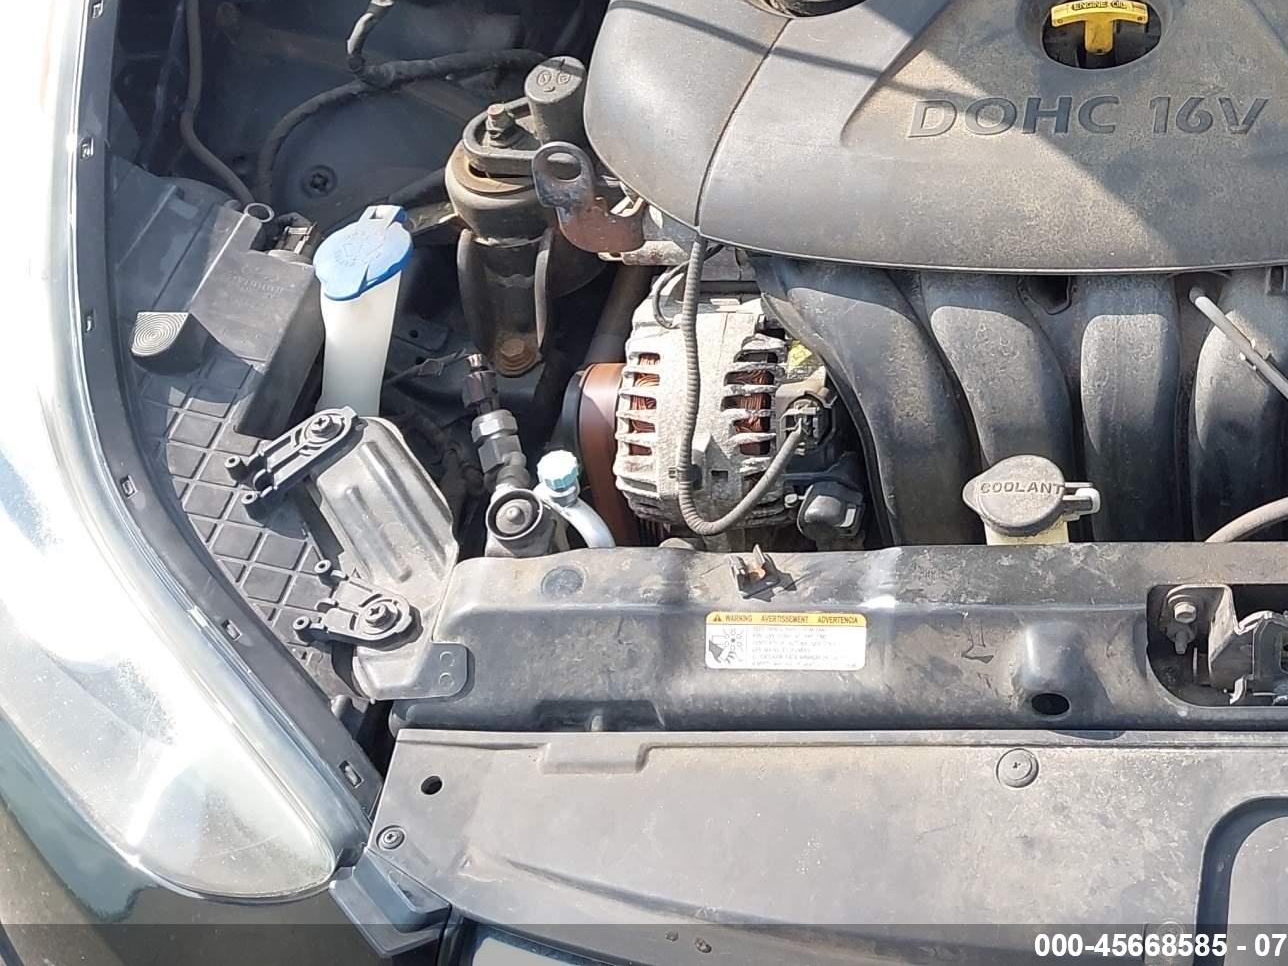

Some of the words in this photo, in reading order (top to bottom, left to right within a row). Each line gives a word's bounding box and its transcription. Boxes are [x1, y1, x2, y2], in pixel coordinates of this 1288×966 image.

[1072, 2, 1109, 11] ENGINE
[1110, 1, 1128, 9] OIL
[908, 95, 1120, 137] DOHC
[1149, 96, 1269, 135] 16V
[981, 481, 1065, 495] COOLANT
[725, 615, 753, 623] WARNING
[761, 615, 809, 623] AVERTISSEMENT
[817, 616, 858, 624] ADVERTENCIA
